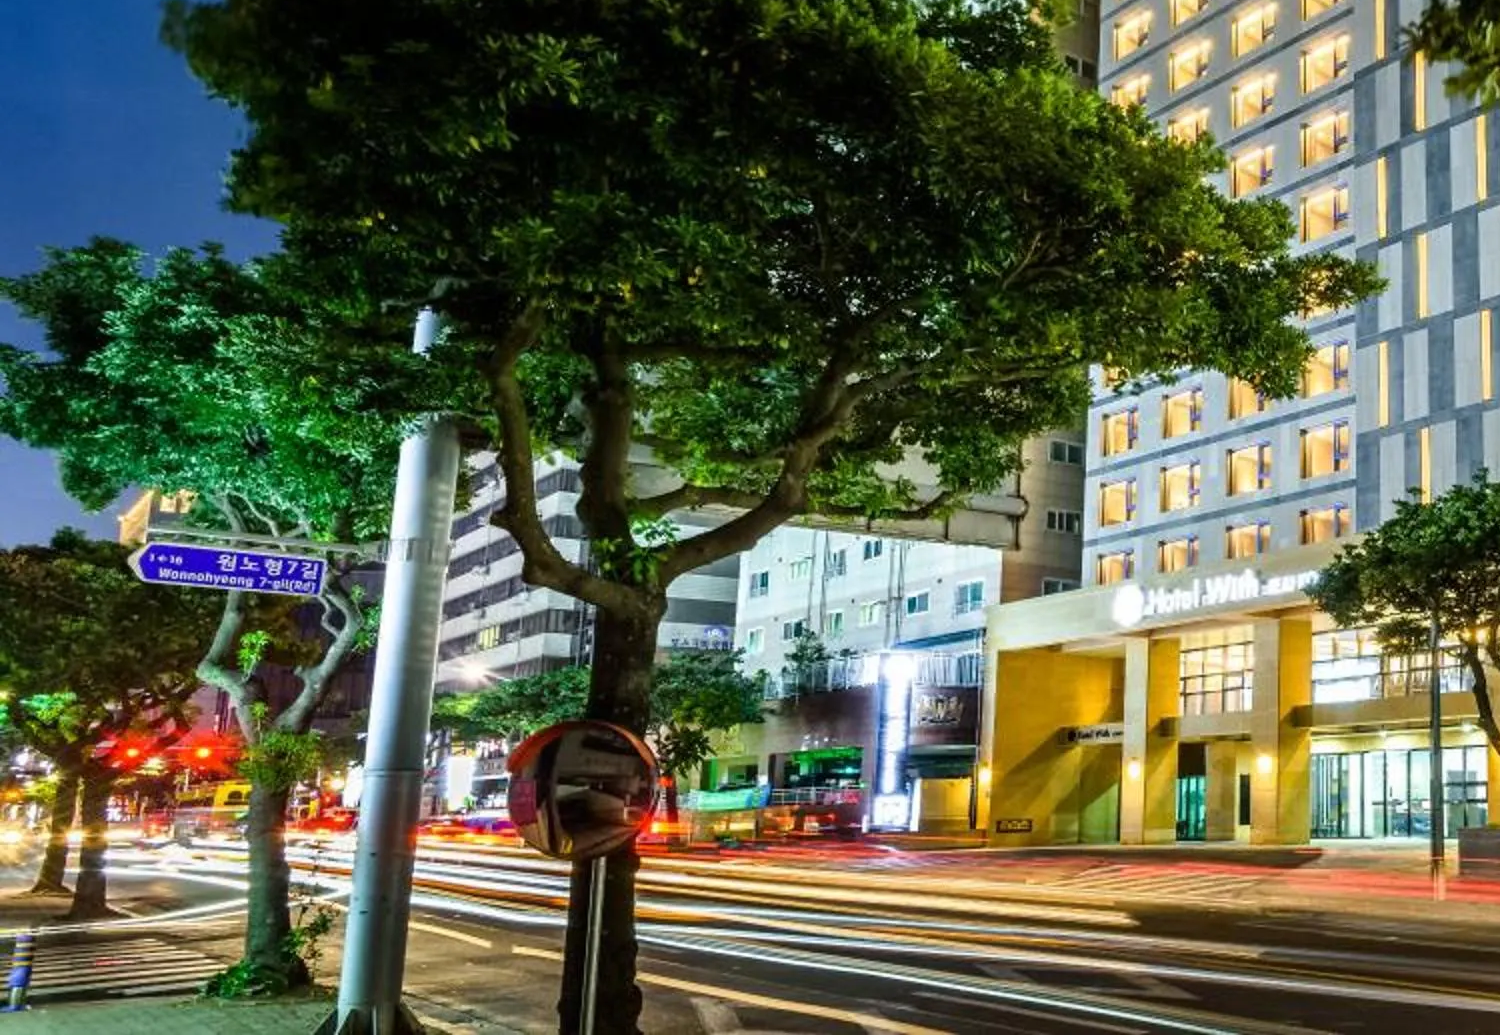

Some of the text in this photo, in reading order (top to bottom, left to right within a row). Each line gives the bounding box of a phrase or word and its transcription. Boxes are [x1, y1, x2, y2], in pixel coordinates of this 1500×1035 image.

[159, 567, 254, 588] Wonnohyeong
[216, 553, 318, 580] 원노형7길
[1147, 578, 1200, 614] Hotel
[1204, 568, 1259, 604] With
